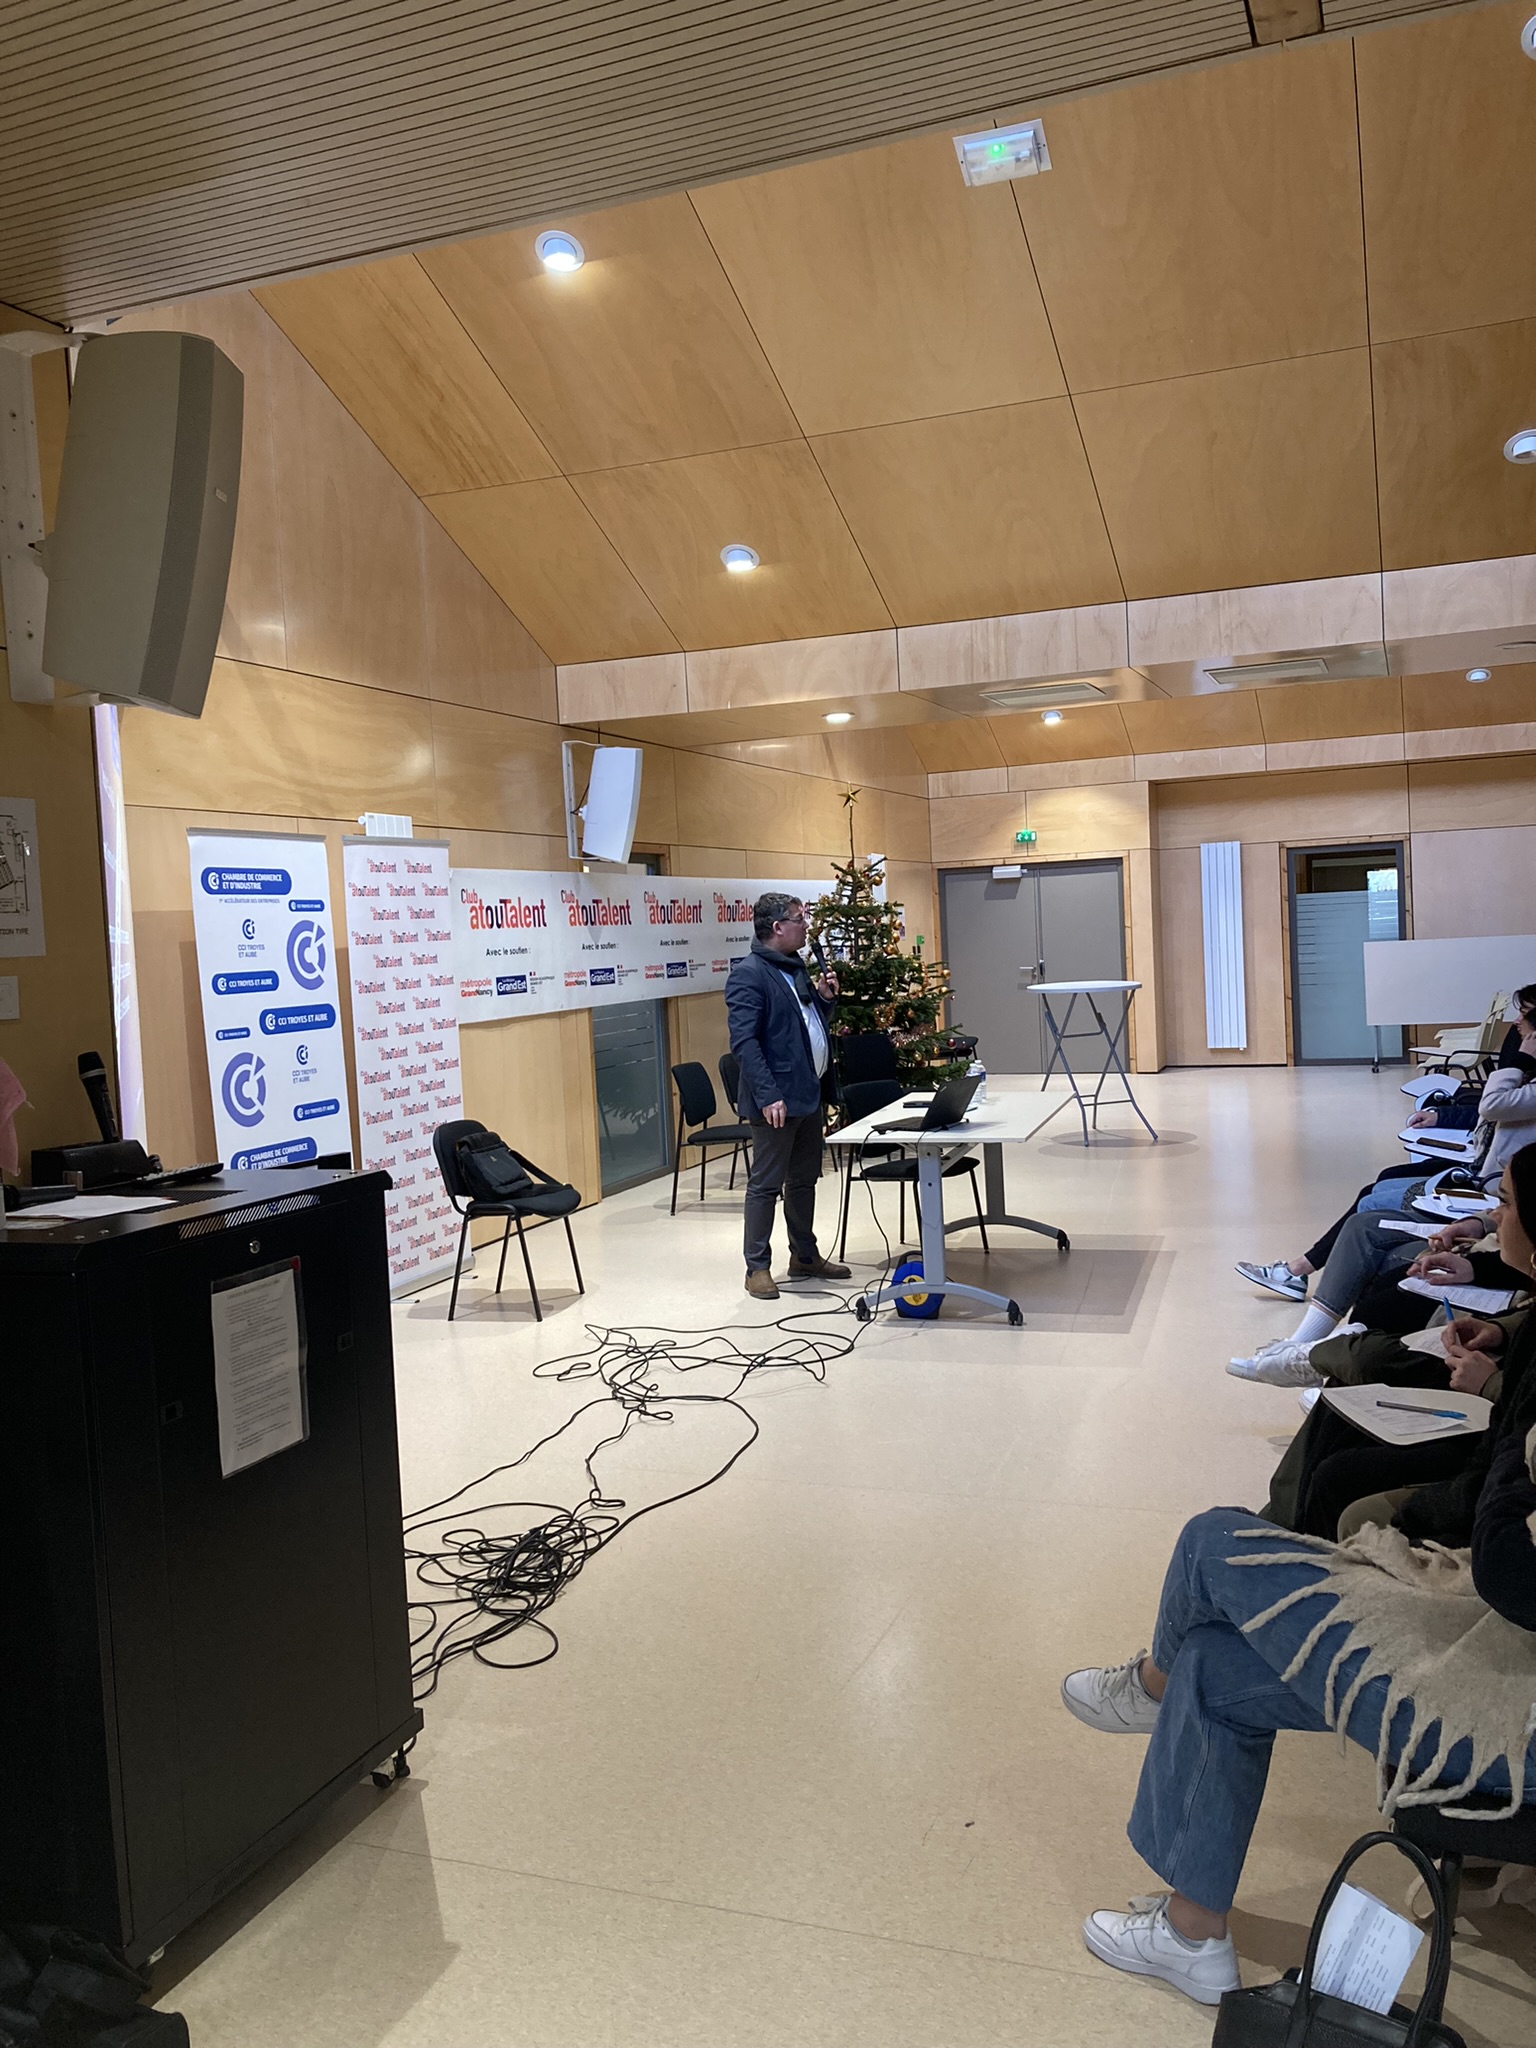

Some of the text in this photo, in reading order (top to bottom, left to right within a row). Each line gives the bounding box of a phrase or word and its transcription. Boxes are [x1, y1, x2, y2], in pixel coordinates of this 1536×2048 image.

[222, 873, 247, 881] CHAMBRE
[461, 889, 478, 904] Club
[560, 890, 575, 903] Club
[470, 897, 547, 929] atouTalent
[568, 898, 632, 927] atouTalent
[650, 898, 702, 925] atouTalent
[717, 899, 753, 923] atouTale
[460, 978, 492, 989] métropole
[288, 1015, 307, 1024] TROYES
[315, 1013, 328, 1021] AUBE
[250, 1143, 308, 1162] CHAMBRE DE COMMERCE
[251, 1161, 258, 1170] ET
